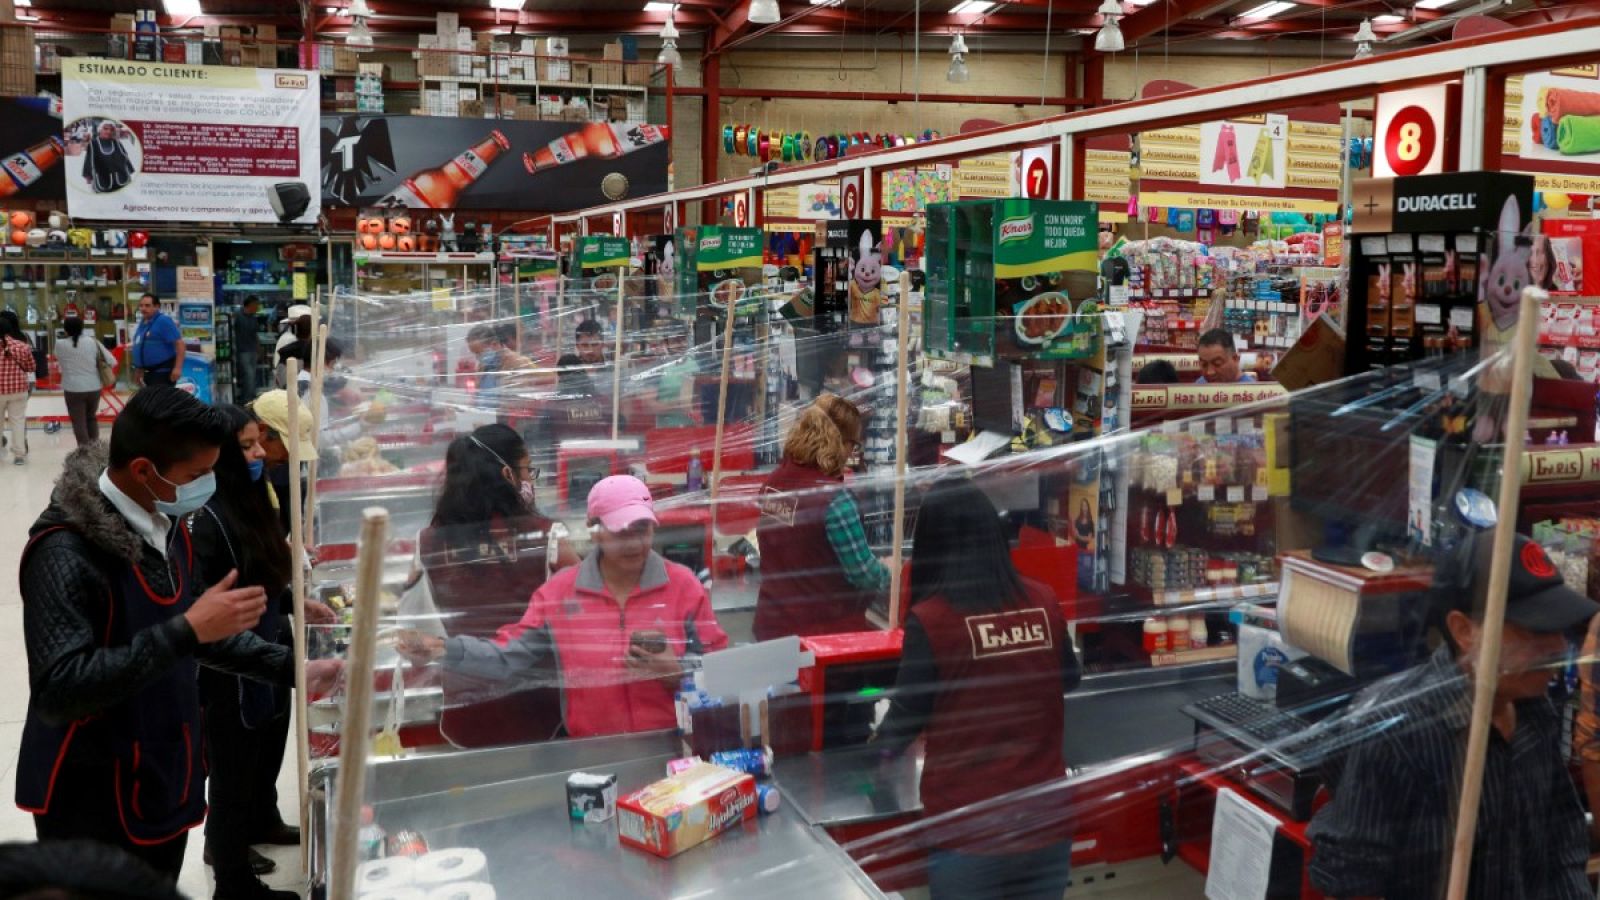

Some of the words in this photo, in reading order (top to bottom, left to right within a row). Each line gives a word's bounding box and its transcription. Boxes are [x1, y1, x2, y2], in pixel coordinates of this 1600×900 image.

[79, 63, 147, 77] ESTIMADO
[153, 67, 208, 80] CLIENTE:
[1272, 126, 1281, 137] 4
[1396, 122, 1422, 161] 8
[1146, 167, 1197, 178] Insecticidas
[1032, 169, 1044, 195] 7
[1552, 179, 1561, 189] Su
[1563, 180, 1588, 191] Dinero
[846, 190, 855, 212] 6
[1397, 193, 1476, 213] DURACELL
[123, 203, 179, 213] Agradecemos
[191, 205, 241, 214] comprensión
[1044, 214, 1059, 225] CON
[1001, 221, 1032, 237] Knorr
[1044, 226, 1062, 237] TODO
[1044, 238, 1068, 249] MEJOR
[1173, 392, 1195, 404] Haz
[1198, 393, 1209, 404] tu
[1214, 390, 1229, 402] día
[1233, 391, 1254, 402] más
